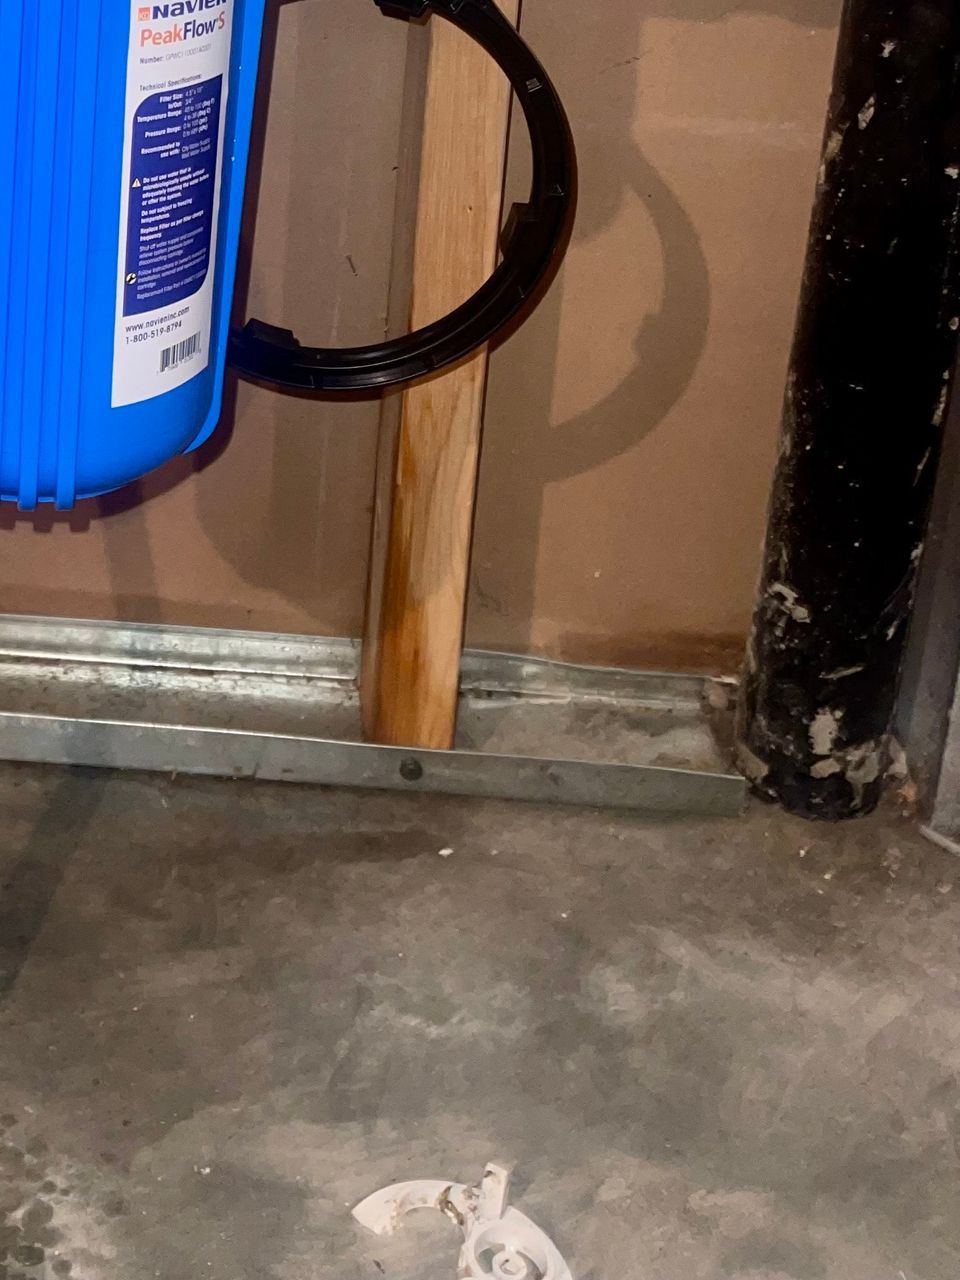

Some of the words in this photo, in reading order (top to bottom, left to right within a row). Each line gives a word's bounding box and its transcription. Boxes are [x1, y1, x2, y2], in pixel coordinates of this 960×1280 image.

[139, 82, 166, 92] Technical
[137, 113, 166, 123] Temperature
[144, 129, 165, 138] Pressure
[125, 306, 189, 333] www.navieninc.com
[125, 320, 181, 345] 1-800-519-8794
